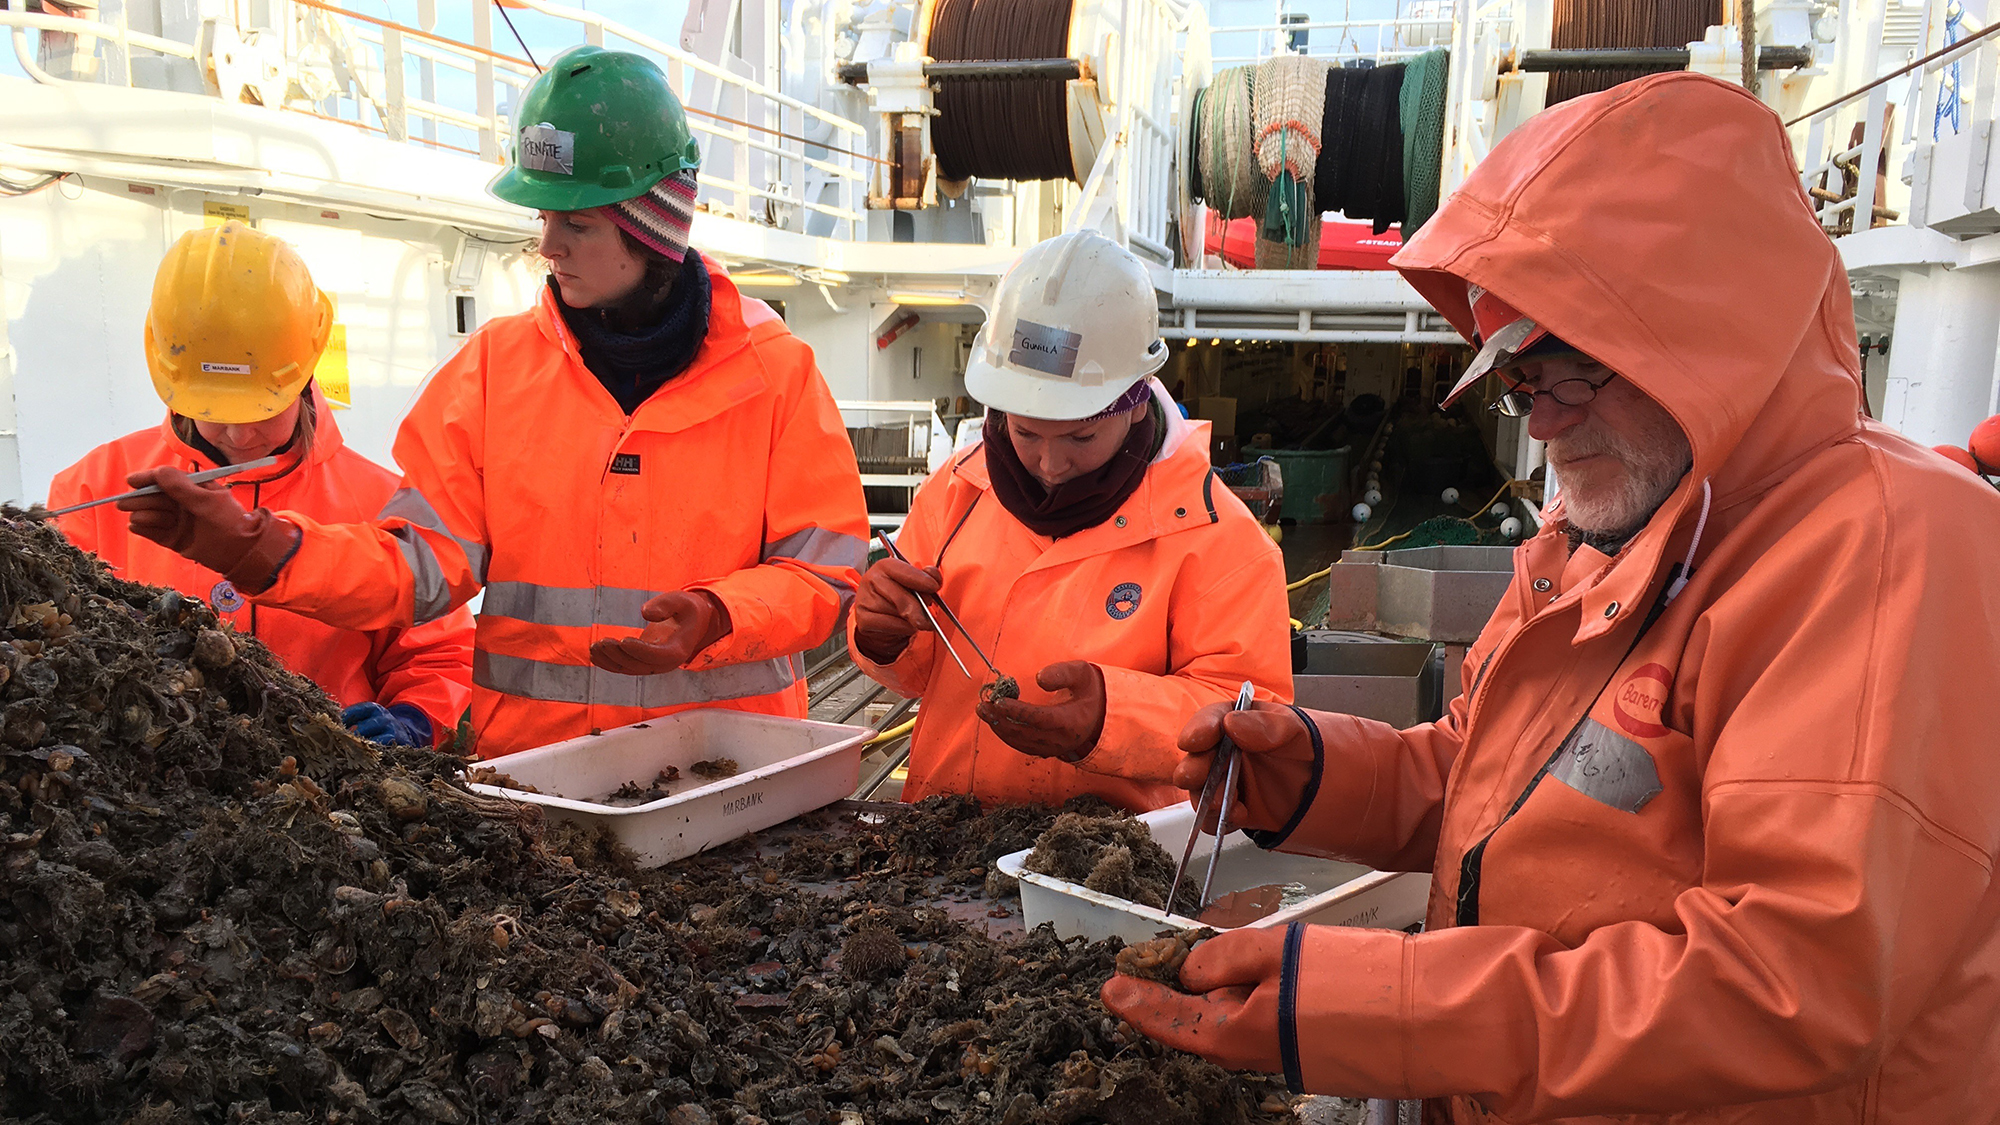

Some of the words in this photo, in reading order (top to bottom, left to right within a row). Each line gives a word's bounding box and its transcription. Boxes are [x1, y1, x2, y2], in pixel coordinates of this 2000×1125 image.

[524, 137, 562, 159] RENATE
[1622, 683, 1665, 712] Baren
[723, 792, 764, 817] MARBANK
[1336, 906, 1379, 928] RBANK
